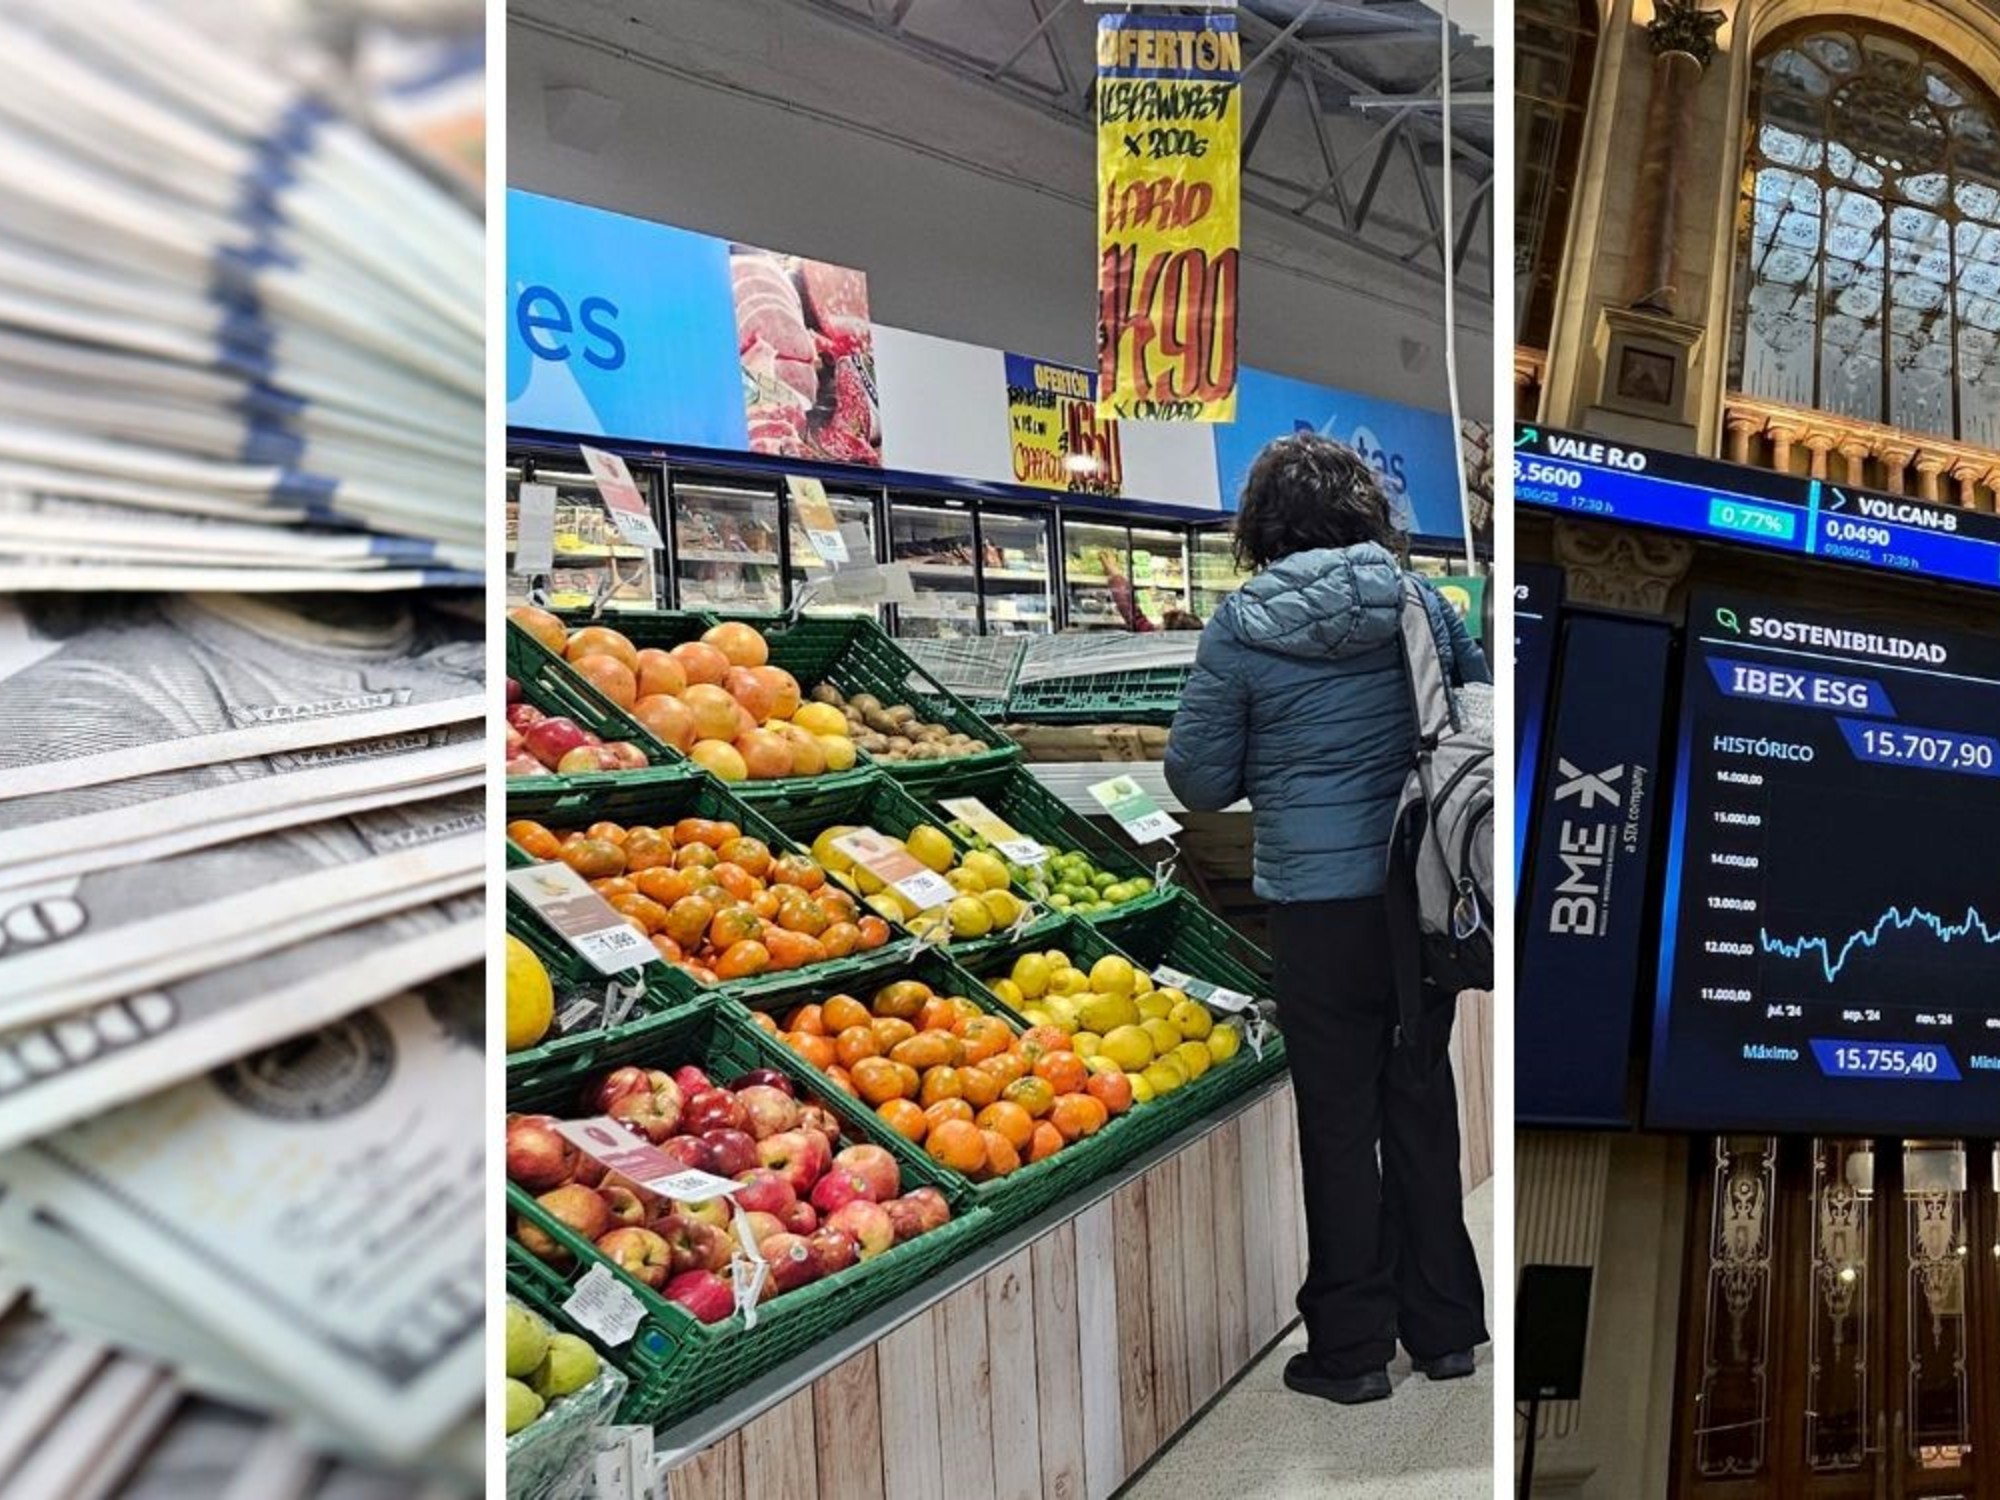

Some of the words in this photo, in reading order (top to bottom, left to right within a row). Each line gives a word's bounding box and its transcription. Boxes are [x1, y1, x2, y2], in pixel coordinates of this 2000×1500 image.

[1547, 435, 1604, 463] VALE
[1607, 448, 1647, 471] R.O
[1720, 505, 1783, 534] 0,77%
[1858, 497, 1957, 531] VOLCAN-B
[1826, 520, 1890, 547] 0,0490
[1749, 617, 1947, 663] SOSTENIBILIDAD
[1733, 667, 1805, 700] IBEX
[1813, 678, 1868, 708] ESG
[263, 694, 384, 721] FRANKLIN
[300, 735, 421, 763] FRANKLIN
[1713, 735, 1815, 762] HISTÓRICO
[1863, 729, 1993, 769] 15.707,90
[1628, 764, 1648, 821] company
[1743, 1043, 1800, 1061] Máximo
[1835, 1047, 1938, 1075] 15.755,40
